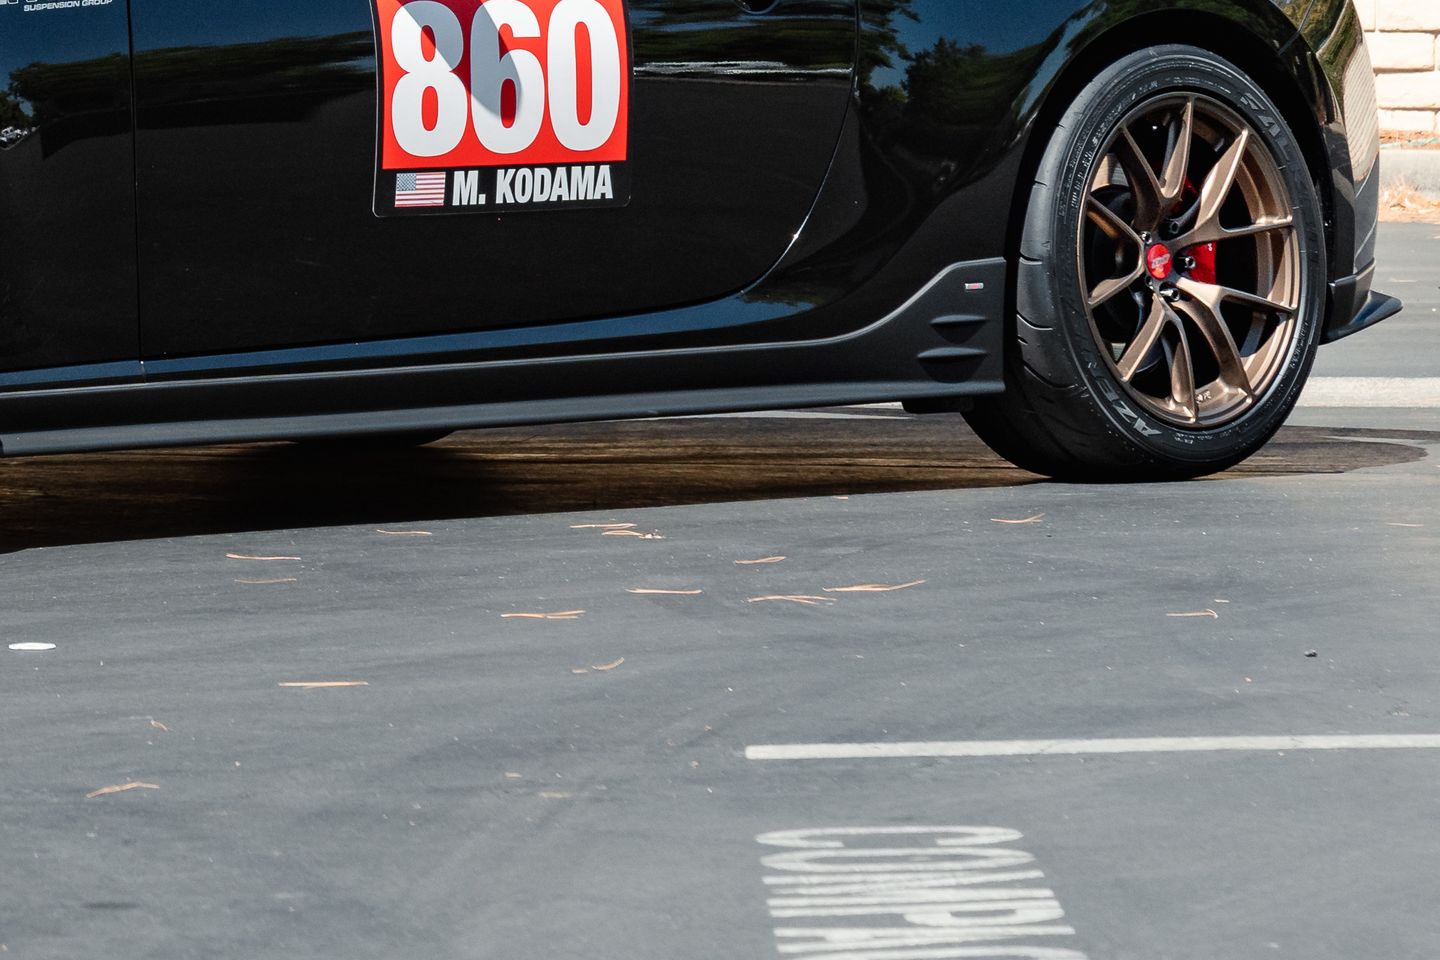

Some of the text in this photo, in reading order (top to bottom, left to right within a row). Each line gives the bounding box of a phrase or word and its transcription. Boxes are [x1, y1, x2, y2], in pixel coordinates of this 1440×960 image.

[23, 0, 81, 12] SUSPENSION
[452, 164, 614, 206] M. KODAMA
